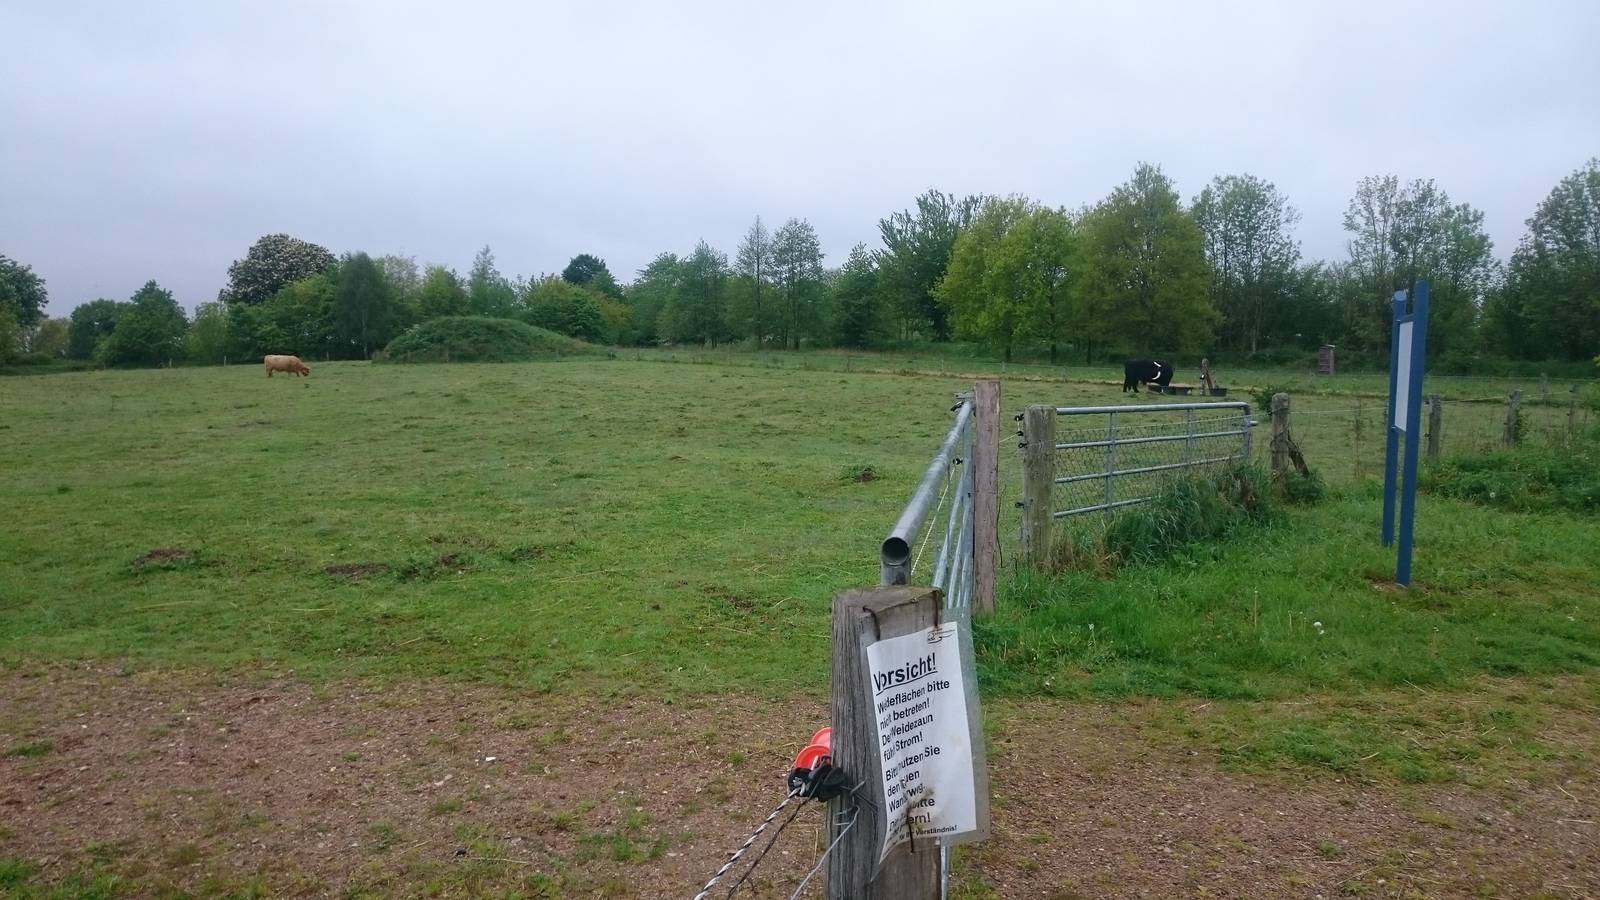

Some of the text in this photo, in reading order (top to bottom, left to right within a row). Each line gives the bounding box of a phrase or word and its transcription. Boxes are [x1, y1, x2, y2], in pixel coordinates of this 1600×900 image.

[873, 652, 937, 692] Vorsicht!
[927, 680, 950, 693] bitte
[893, 697, 930, 721] betreten!
[882, 733, 891, 746] De
[895, 731, 923, 751] Strom!
[924, 745, 941, 758] Sie
